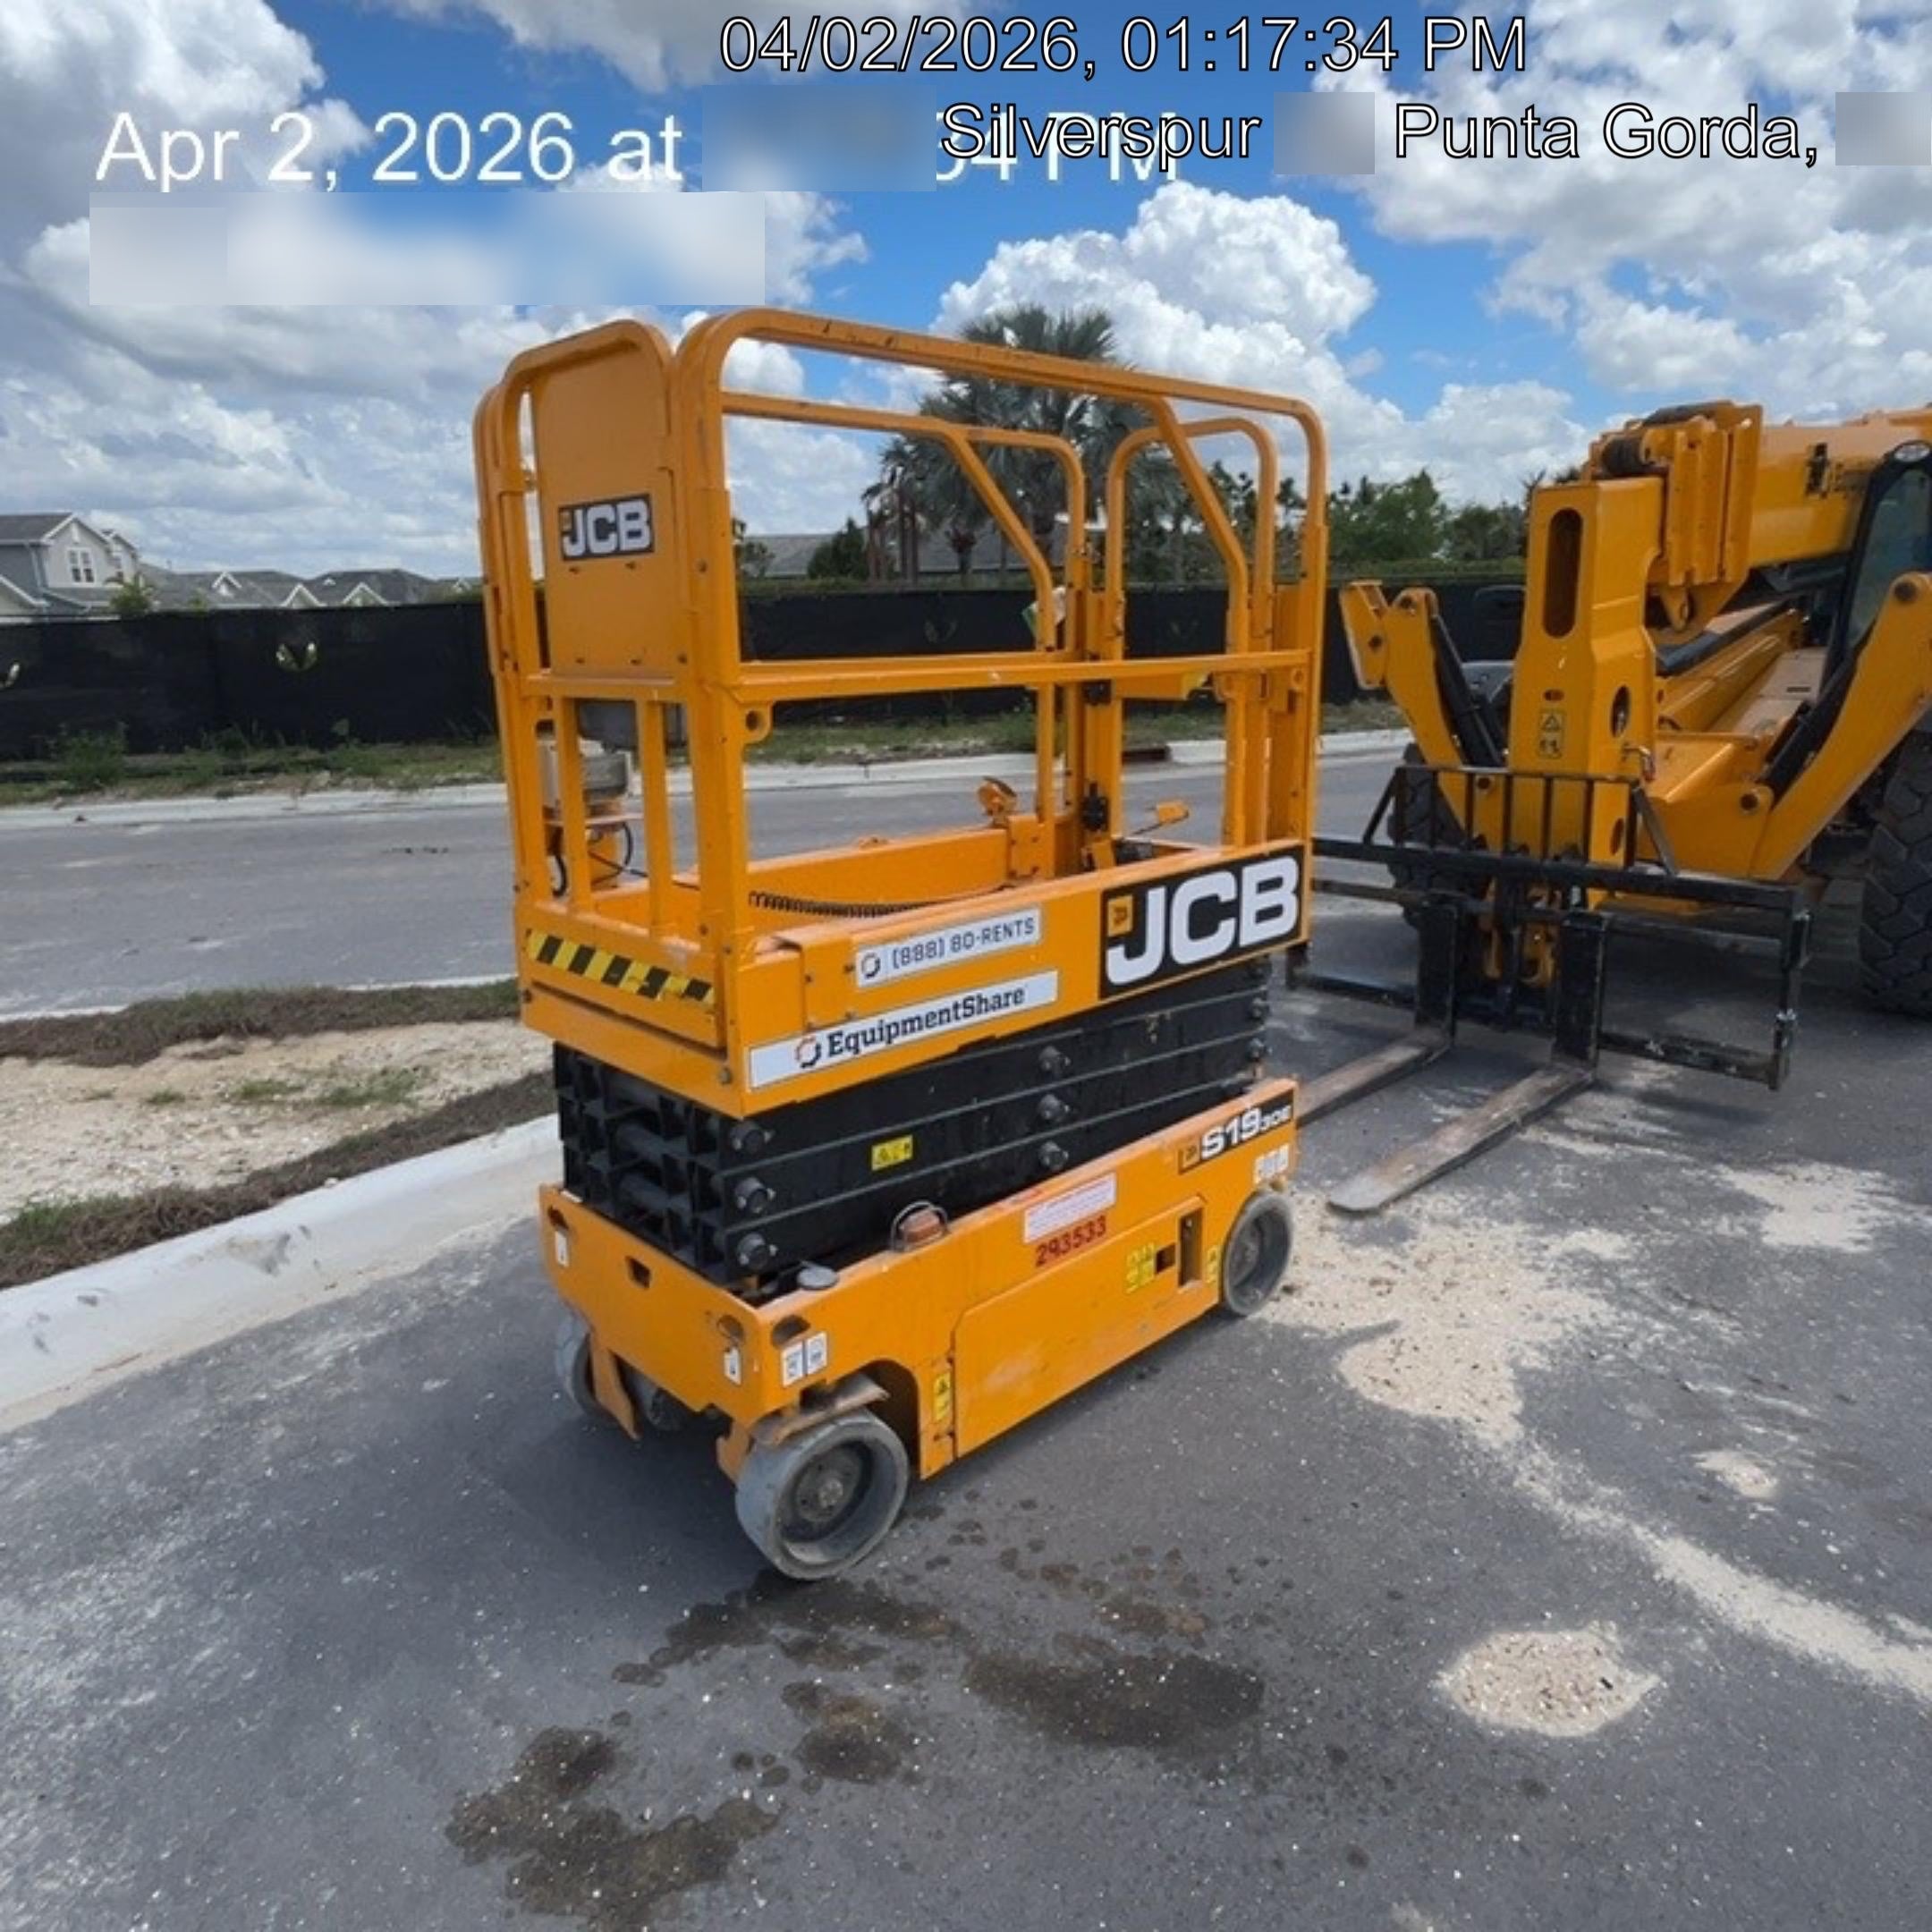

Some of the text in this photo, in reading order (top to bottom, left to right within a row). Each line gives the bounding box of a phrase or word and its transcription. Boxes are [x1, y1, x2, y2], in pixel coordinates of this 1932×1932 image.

[562, 499, 651, 556] JCB
[1106, 855, 1300, 986] JCB
[826, 987, 1025, 1058] EquipmentShare
